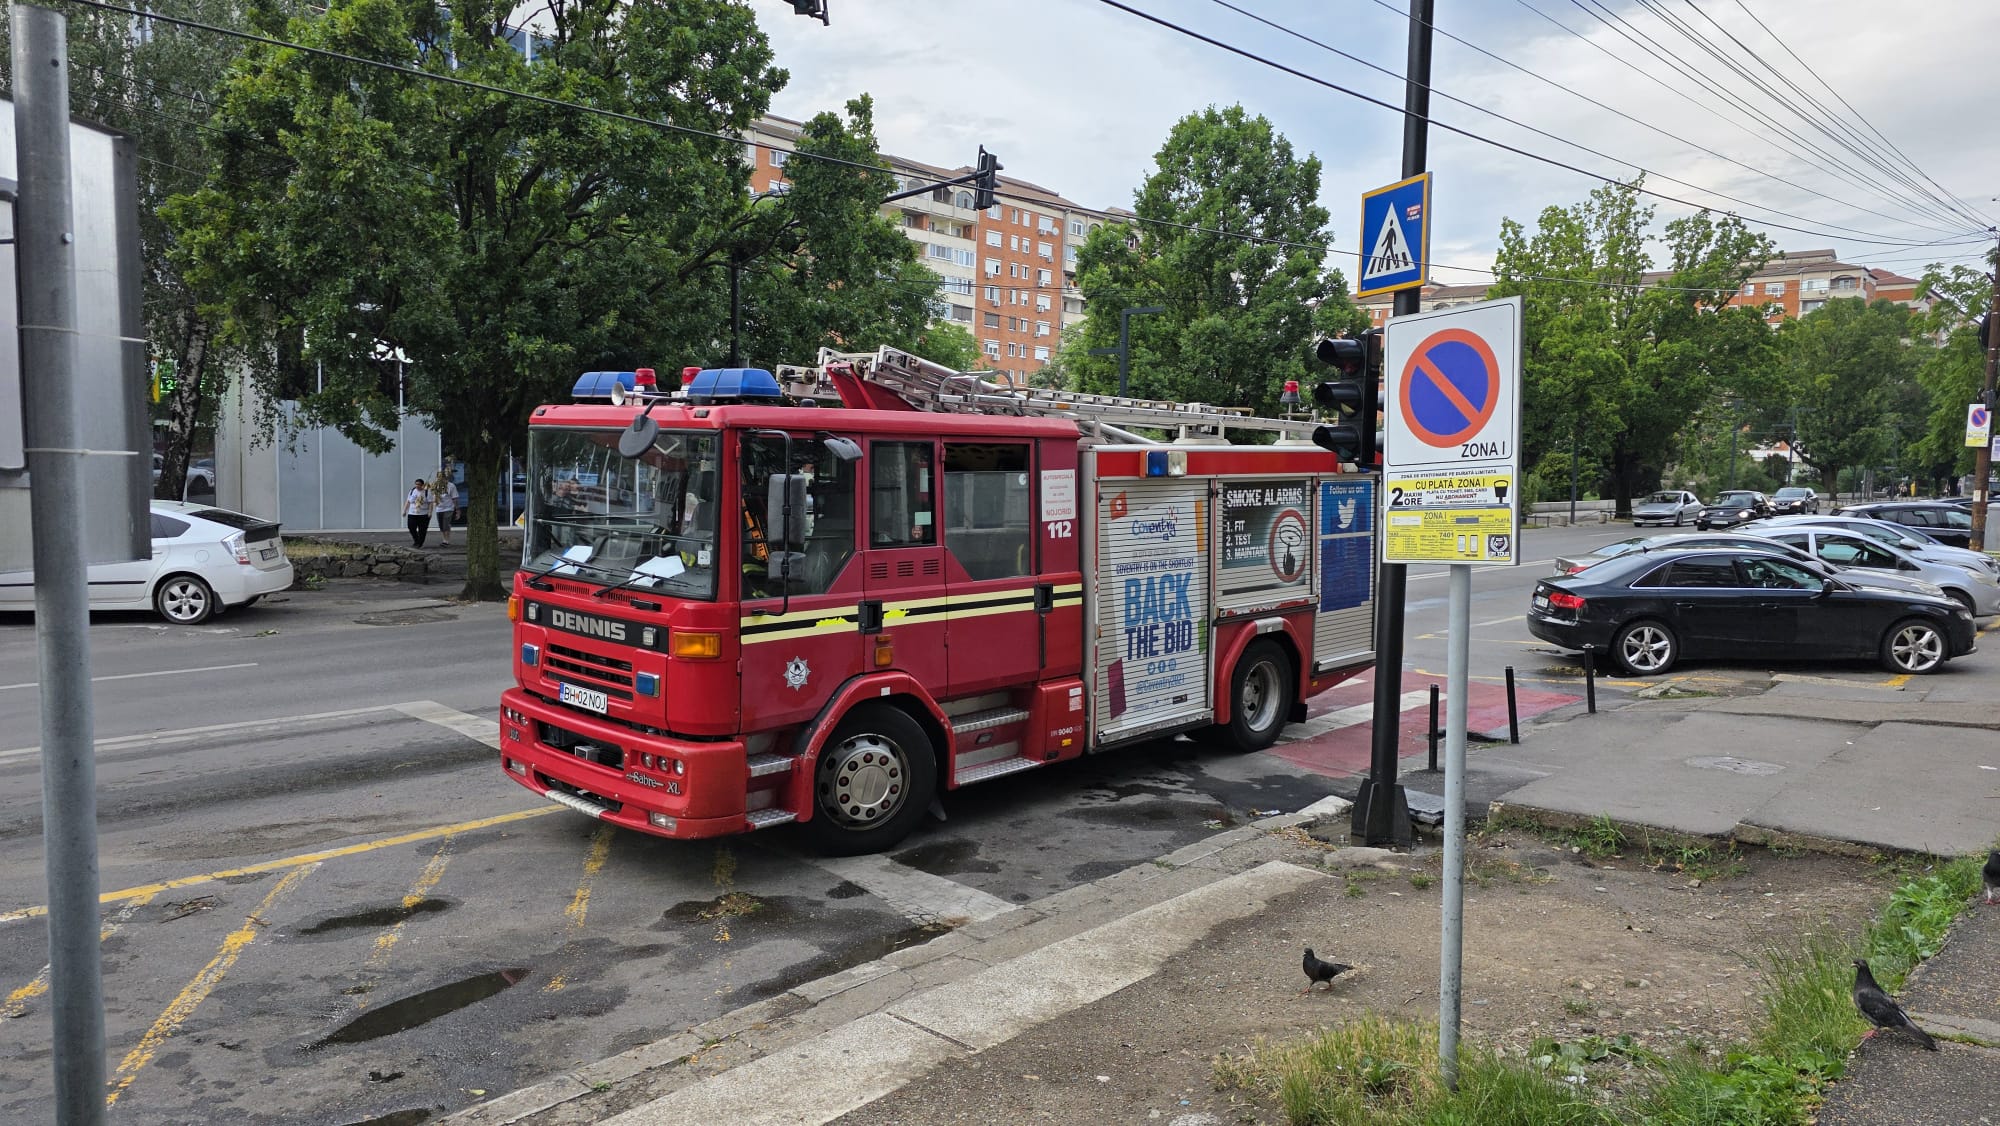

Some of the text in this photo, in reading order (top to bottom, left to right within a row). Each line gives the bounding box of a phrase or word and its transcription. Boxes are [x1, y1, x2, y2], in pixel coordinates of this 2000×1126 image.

[1461, 441, 1505, 458] ZONA I
[1329, 486, 1347, 494] Follow
[1416, 481, 1426, 490] CU
[1428, 478, 1454, 489] PLATĂ
[1458, 479, 1482, 488] ZONA
[1227, 488, 1303, 508] SMOKE ALARMS
[1392, 487, 1403, 505] 2
[1046, 508, 1072, 516] NOJORID
[1048, 521, 1072, 538] 112
[1132, 517, 1176, 537] Coventry
[1226, 520, 1245, 532] 1. FIT
[1226, 534, 1251, 546] 2. TEST
[1226, 546, 1267, 560] 3. MAINTAIN
[1116, 558, 1194, 574] COVENTRY IS ON THE SHORTLIST
[1125, 572, 1192, 626] BACK
[552, 609, 626, 640] DENNIS
[1125, 619, 1192, 660] THE BID
[564, 686, 605, 710] BH 02 NOJ
[1058, 727, 1073, 735] 9040
[634, 771, 680, 795] Sabre XL
